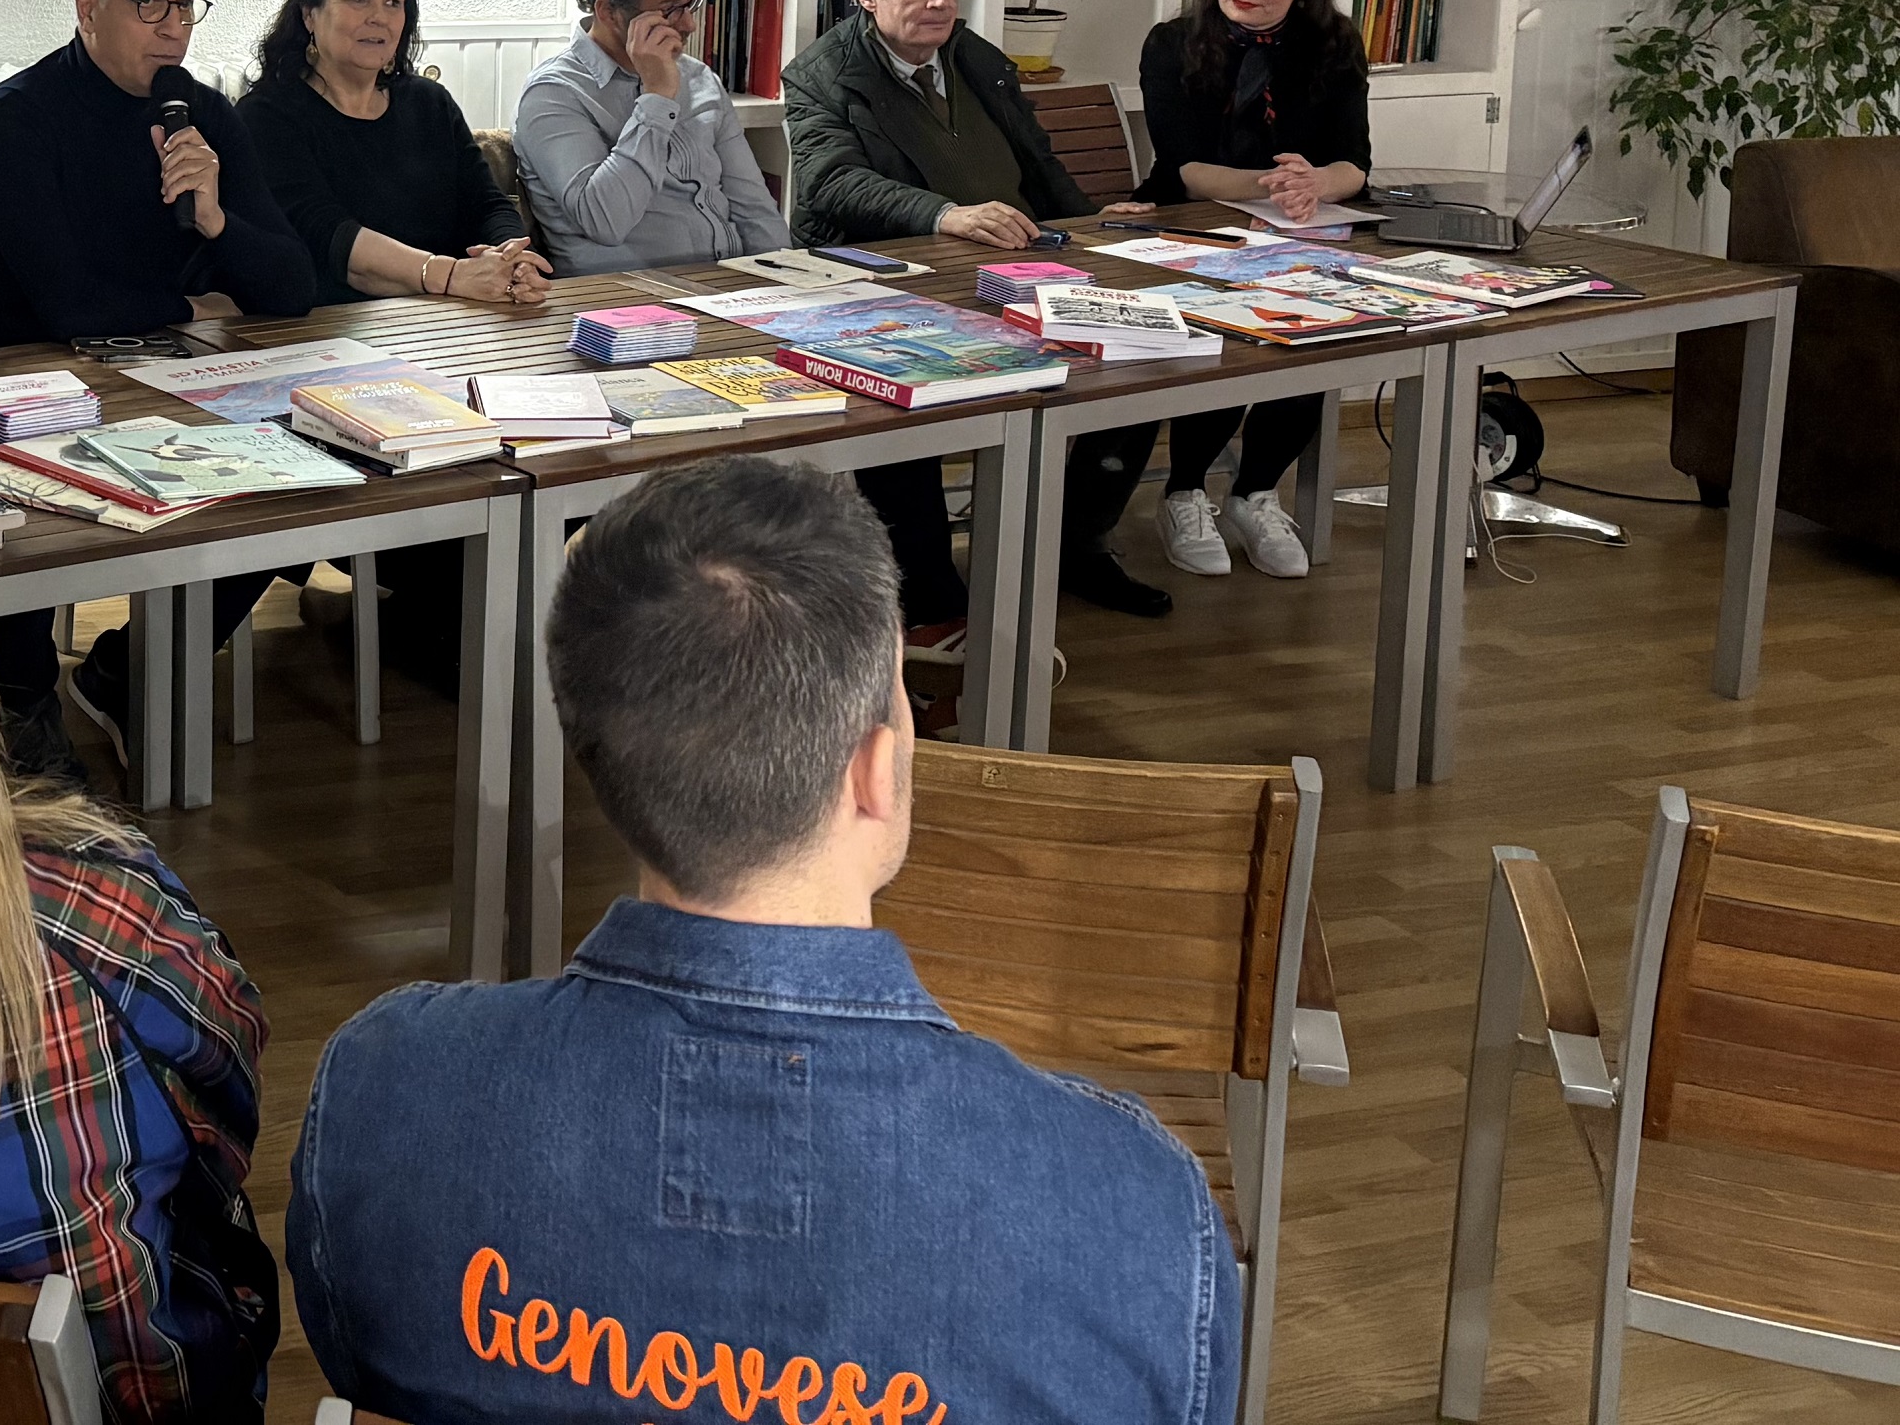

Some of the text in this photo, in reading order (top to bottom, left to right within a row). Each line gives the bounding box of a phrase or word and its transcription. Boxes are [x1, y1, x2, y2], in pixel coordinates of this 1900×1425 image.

[205, 360, 264, 372] BASTIA
[805, 358, 844, 383] ROMA
[844, 371, 898, 400] DETROIT
[460, 1246, 948, 1425] Genovese
